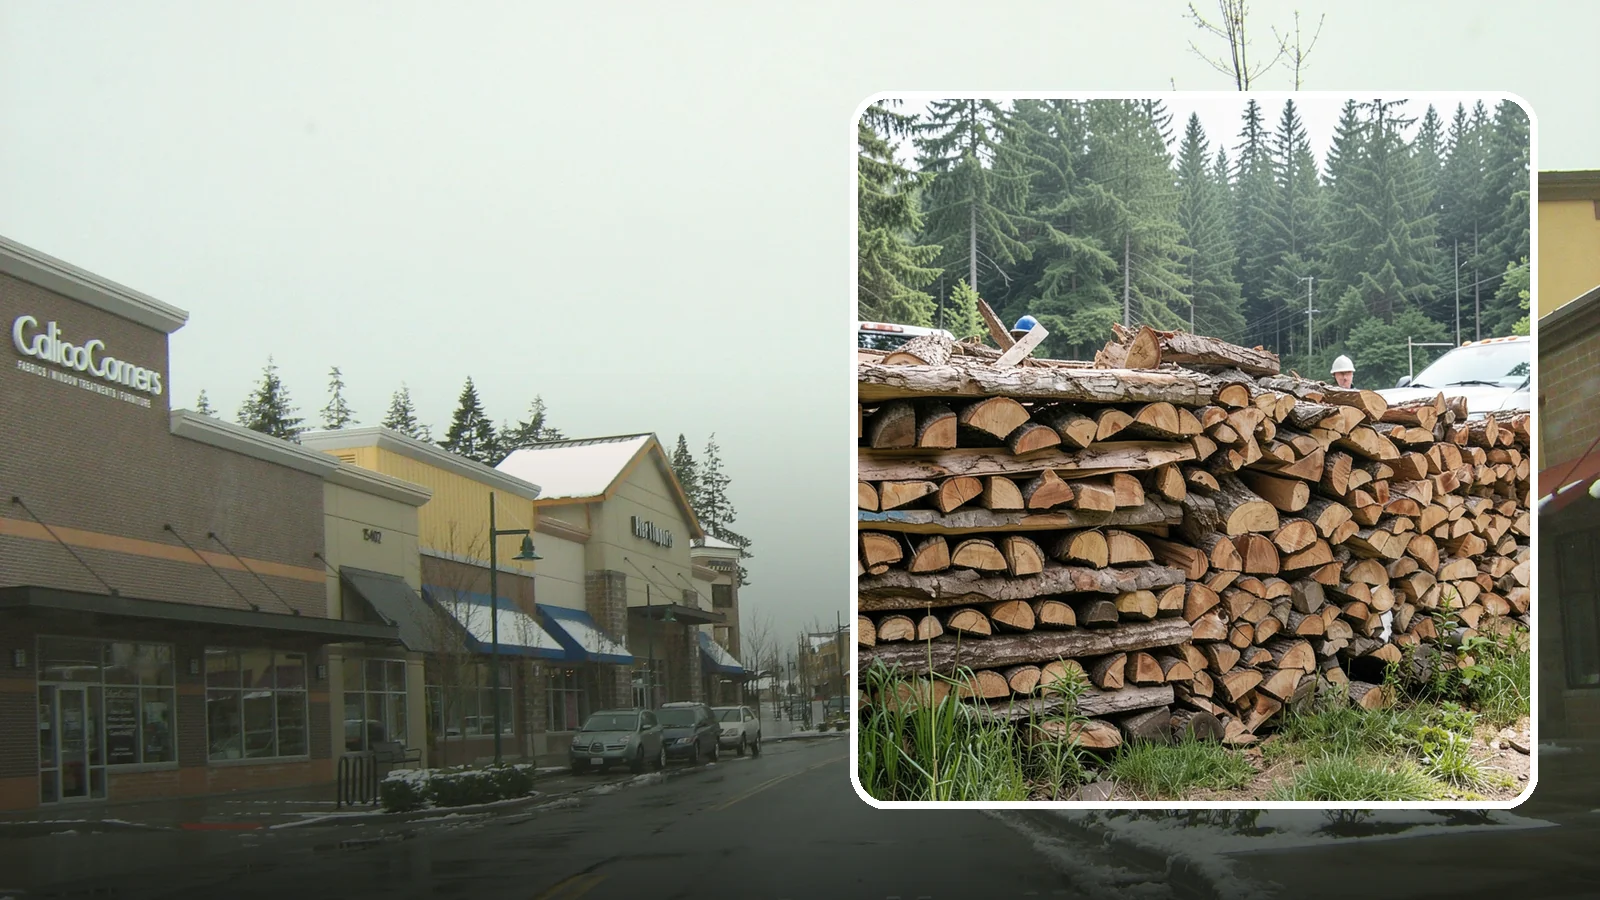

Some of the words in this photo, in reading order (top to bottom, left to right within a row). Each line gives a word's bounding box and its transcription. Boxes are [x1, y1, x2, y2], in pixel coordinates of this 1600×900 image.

[17, 360, 48, 377] FABRICS
[51, 371, 78, 387] WINDOW
[78, 379, 116, 398] TREATMENTS
